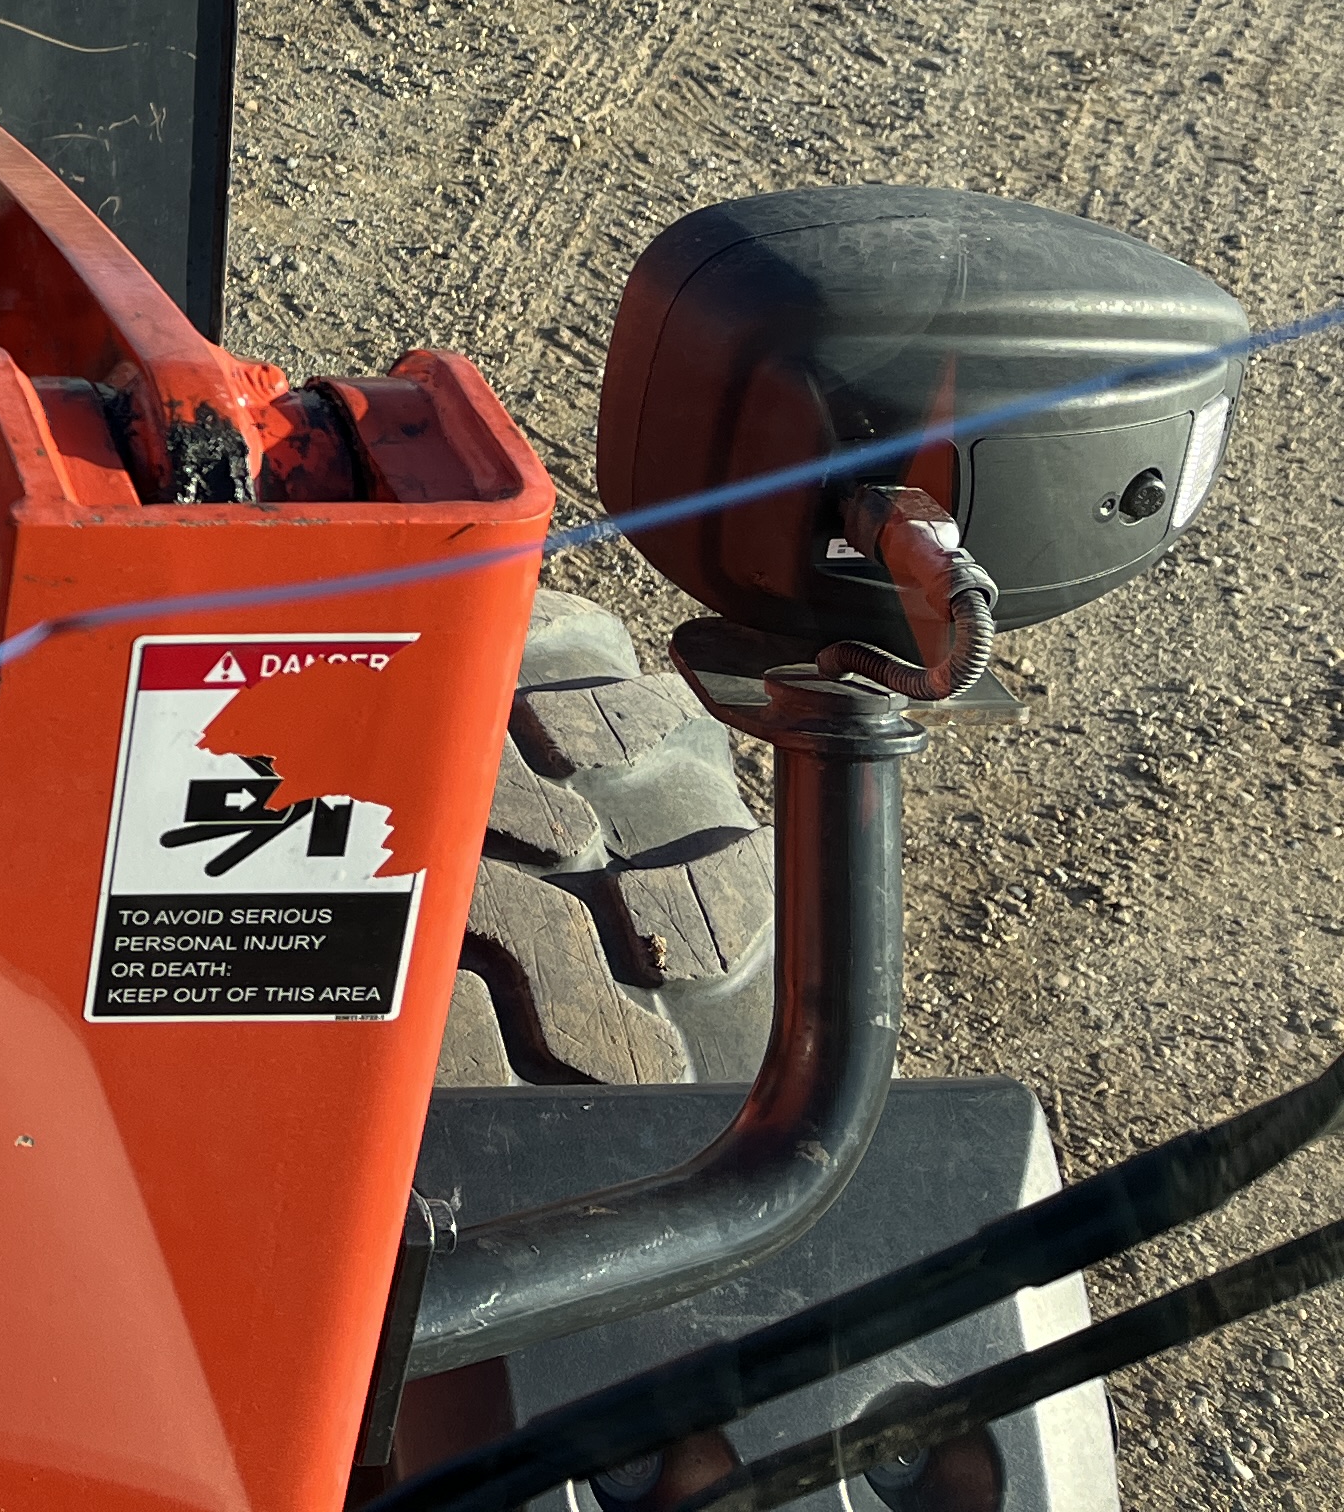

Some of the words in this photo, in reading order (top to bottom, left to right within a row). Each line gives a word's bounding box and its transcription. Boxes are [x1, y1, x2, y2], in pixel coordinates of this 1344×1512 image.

[119, 911, 149, 925] TO
[154, 910, 223, 924] AVOID
[230, 909, 332, 924] SERIOUS
[115, 936, 236, 951] PERSONAL
[244, 936, 326, 950] INJURY
[112, 963, 144, 977] OR
[152, 962, 231, 977] DEATH:
[108, 989, 167, 1003] KEEP
[174, 988, 221, 1002] OUT
[227, 988, 258, 1001] OF
[265, 987, 314, 1001] THIS
[319, 987, 380, 1001] AREA
